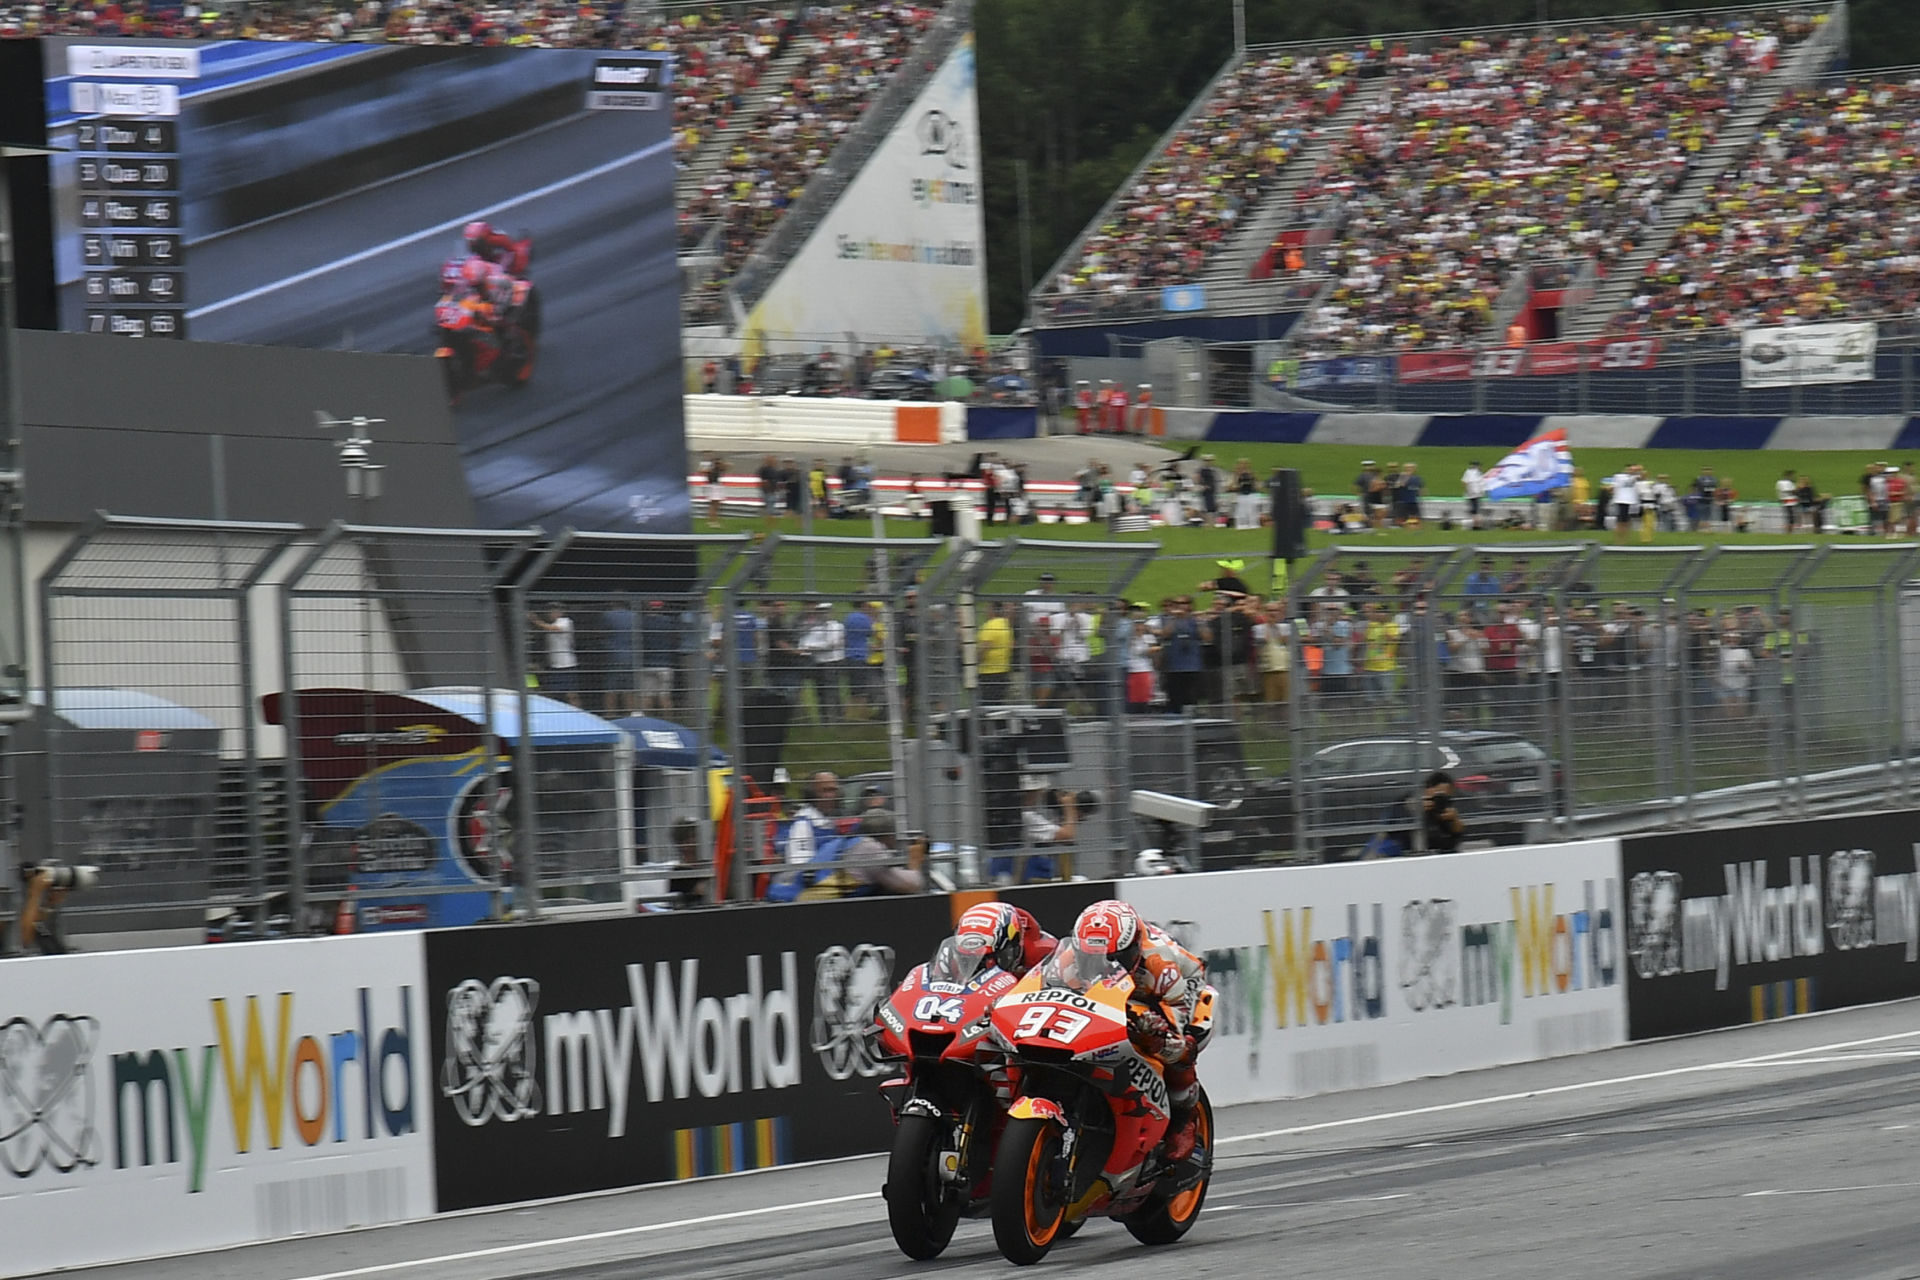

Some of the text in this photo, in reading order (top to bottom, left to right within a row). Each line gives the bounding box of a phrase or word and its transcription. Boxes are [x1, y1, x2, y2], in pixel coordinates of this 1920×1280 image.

[79, 125, 96, 143] 2
[81, 164, 97, 181] 3
[82, 202, 99, 219] 4
[144, 202, 170, 219] 46
[86, 239, 101, 256] 5
[148, 240, 172, 257] 12
[87, 277, 104, 295] 6
[148, 277, 174, 295] 42
[89, 315, 105, 332] 7
[1681, 855, 1824, 991] myWorld
[1461, 877, 1618, 1025] myWorld
[1021, 990, 1097, 1012] REPSOL
[1203, 903, 1388, 1078] myWorld
[880, 1007, 904, 1034] Lenovo
[914, 995, 964, 1024] 04
[1013, 1006, 1091, 1044] 93
[543, 951, 801, 1138] myWorld
[109, 985, 415, 1193] myWorld
[1126, 1056, 1168, 1109] REPSOL
